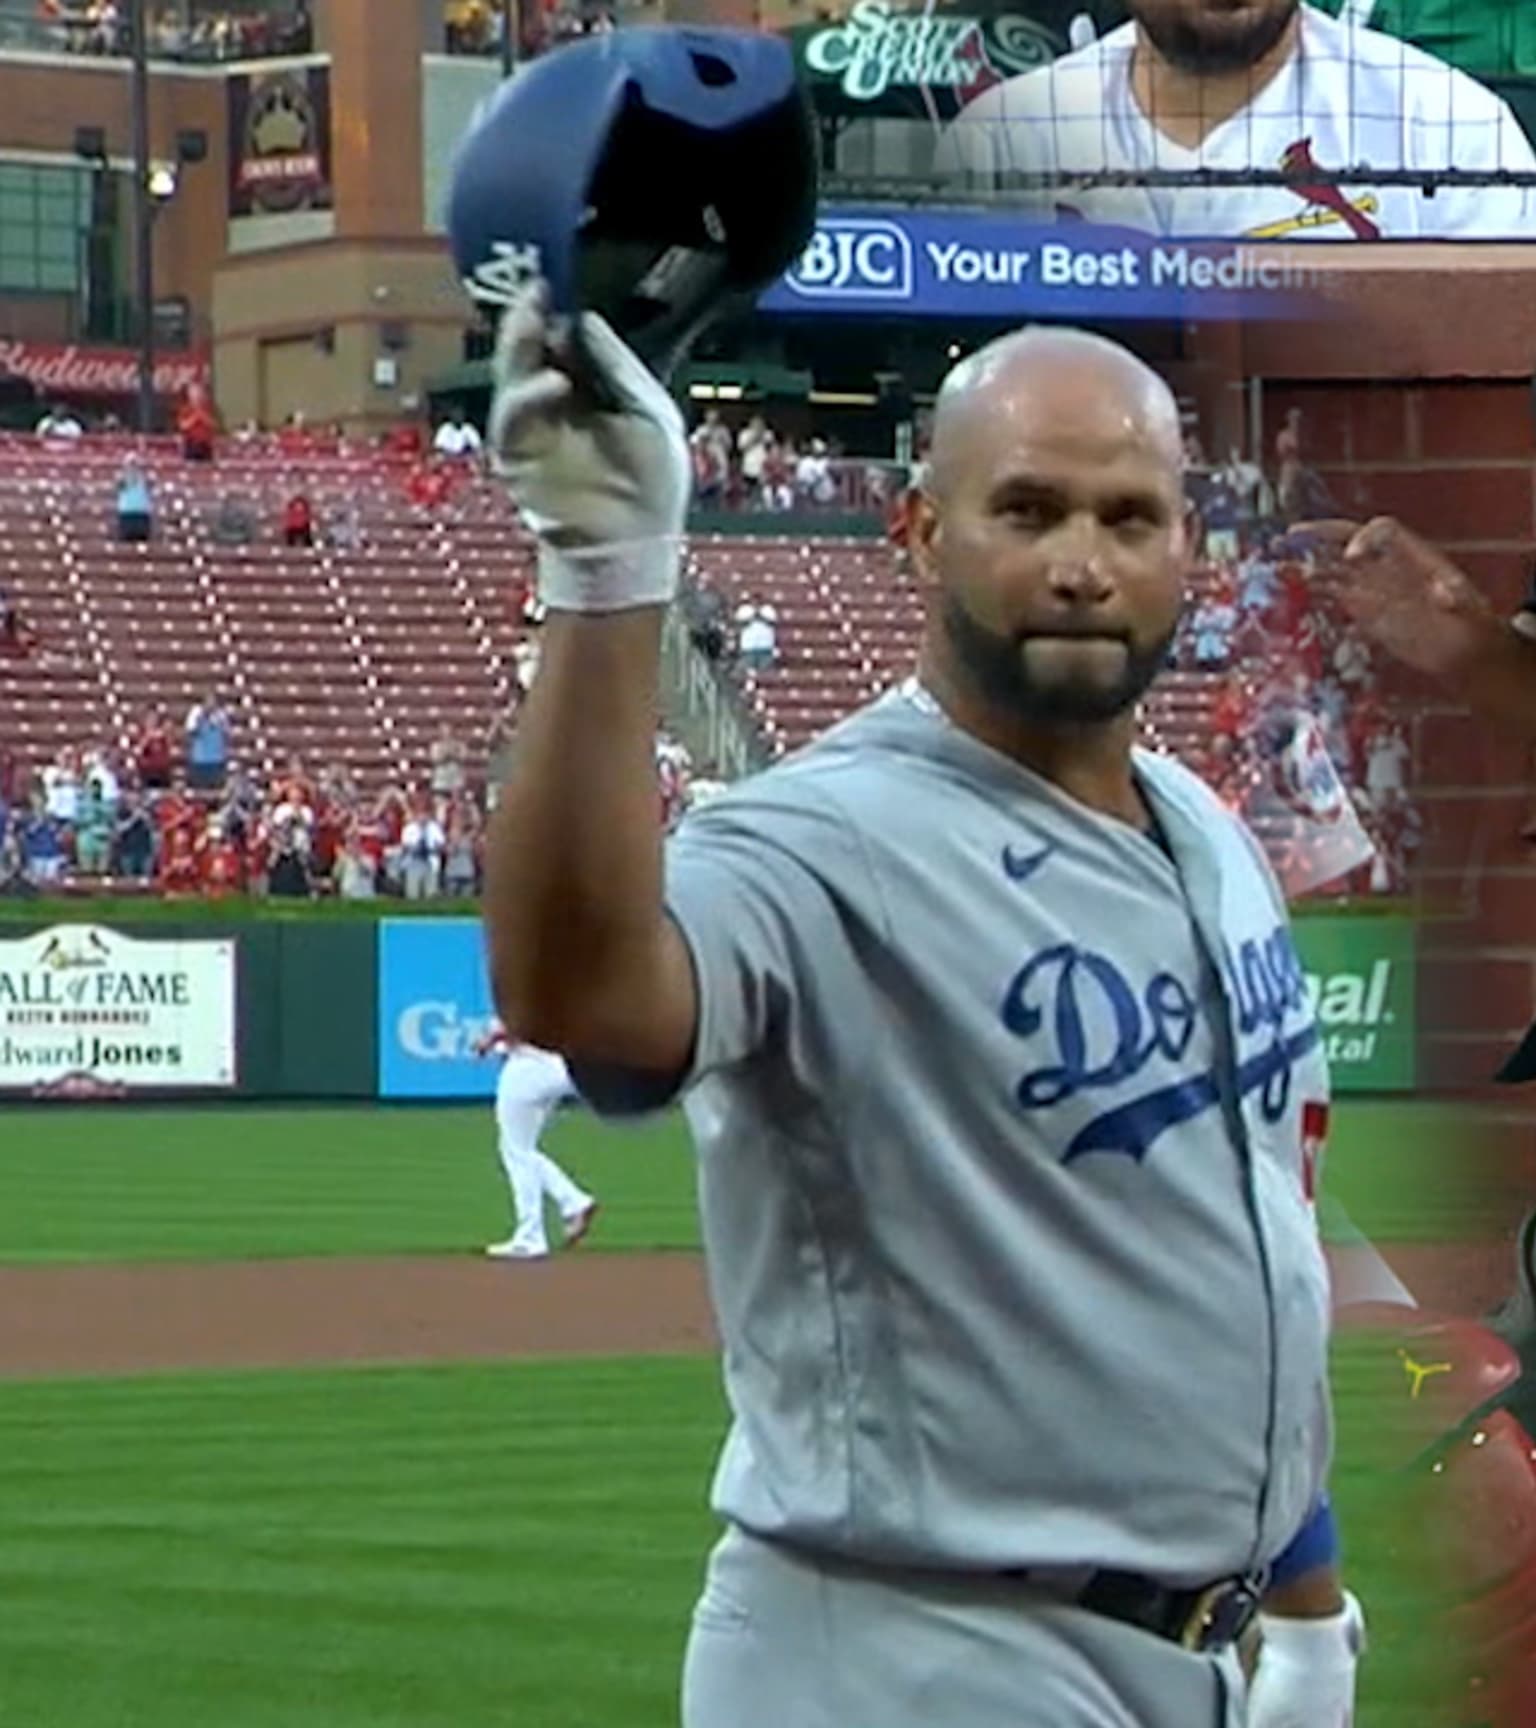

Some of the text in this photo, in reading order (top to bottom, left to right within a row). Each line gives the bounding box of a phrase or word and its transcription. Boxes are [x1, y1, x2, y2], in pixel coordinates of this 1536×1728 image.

[799, 233, 896, 287] BJC
[926, 242, 1326, 289] Your Best Medicin
[96, 972, 191, 1005] FAME
[88, 1037, 182, 1070] Jones
